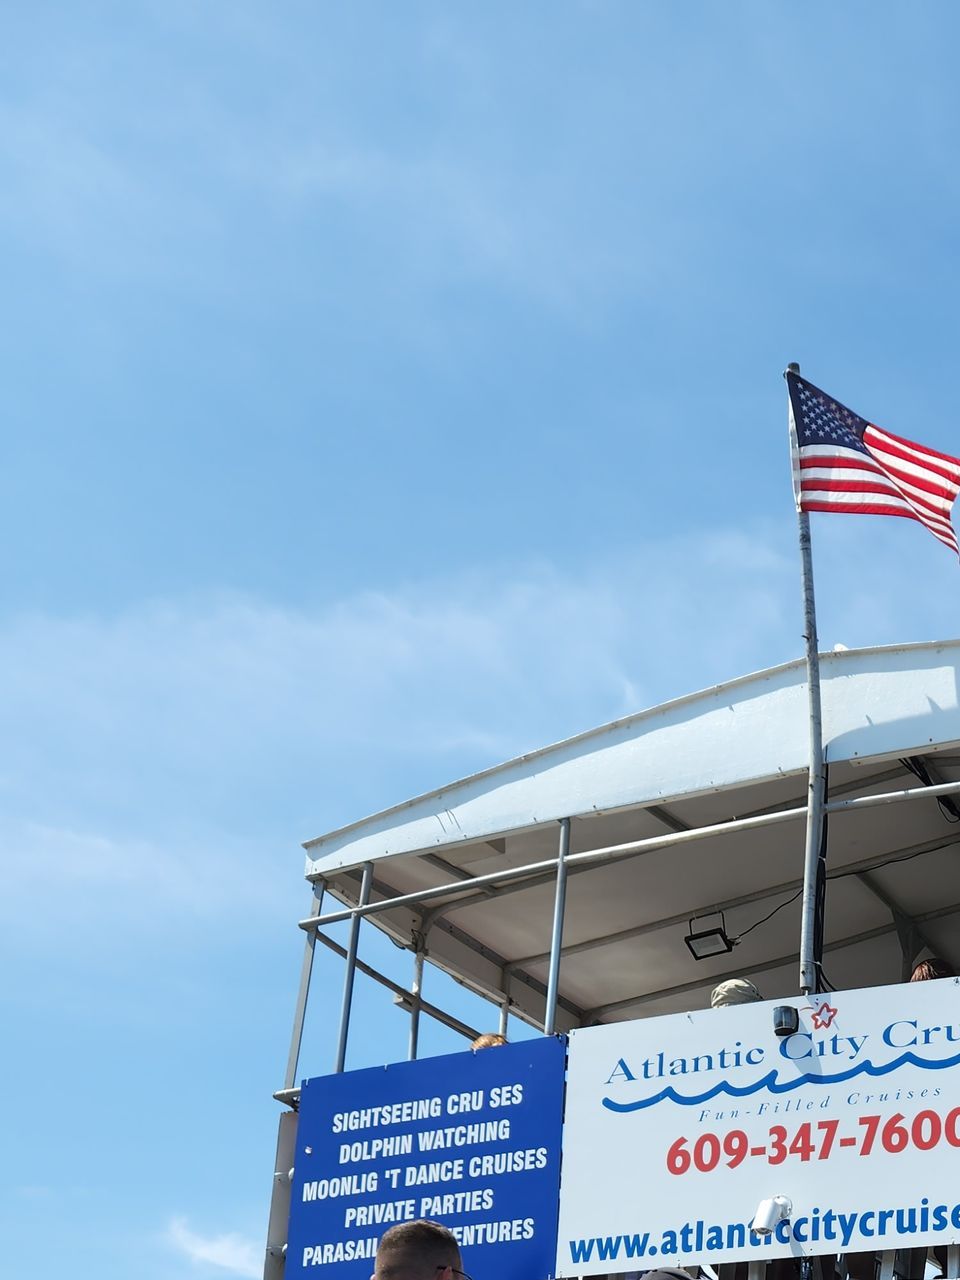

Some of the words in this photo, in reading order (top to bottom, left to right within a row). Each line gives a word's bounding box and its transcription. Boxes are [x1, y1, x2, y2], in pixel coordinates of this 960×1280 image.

[604, 1042, 765, 1084] Atlantic
[779, 1033, 869, 1060] City
[332, 1097, 441, 1133] SIGHTSEEING
[446, 1083, 523, 1115] CRUSES
[699, 1095, 832, 1121] Fun-Filled
[847, 1086, 942, 1106] Cruises
[339, 1134, 412, 1164] DOLPHIN
[418, 1119, 510, 1151] WATCHING
[302, 1168, 401, 1202] MOONLIGT
[405, 1159, 463, 1186] DANCE
[469, 1147, 547, 1178] CRUISES
[345, 1200, 415, 1228] PRIVATE
[420, 1188, 494, 1218] PARTIES
[303, 1238, 378, 1267] PARASAIL
[447, 1218, 534, 1247] ENTURES
